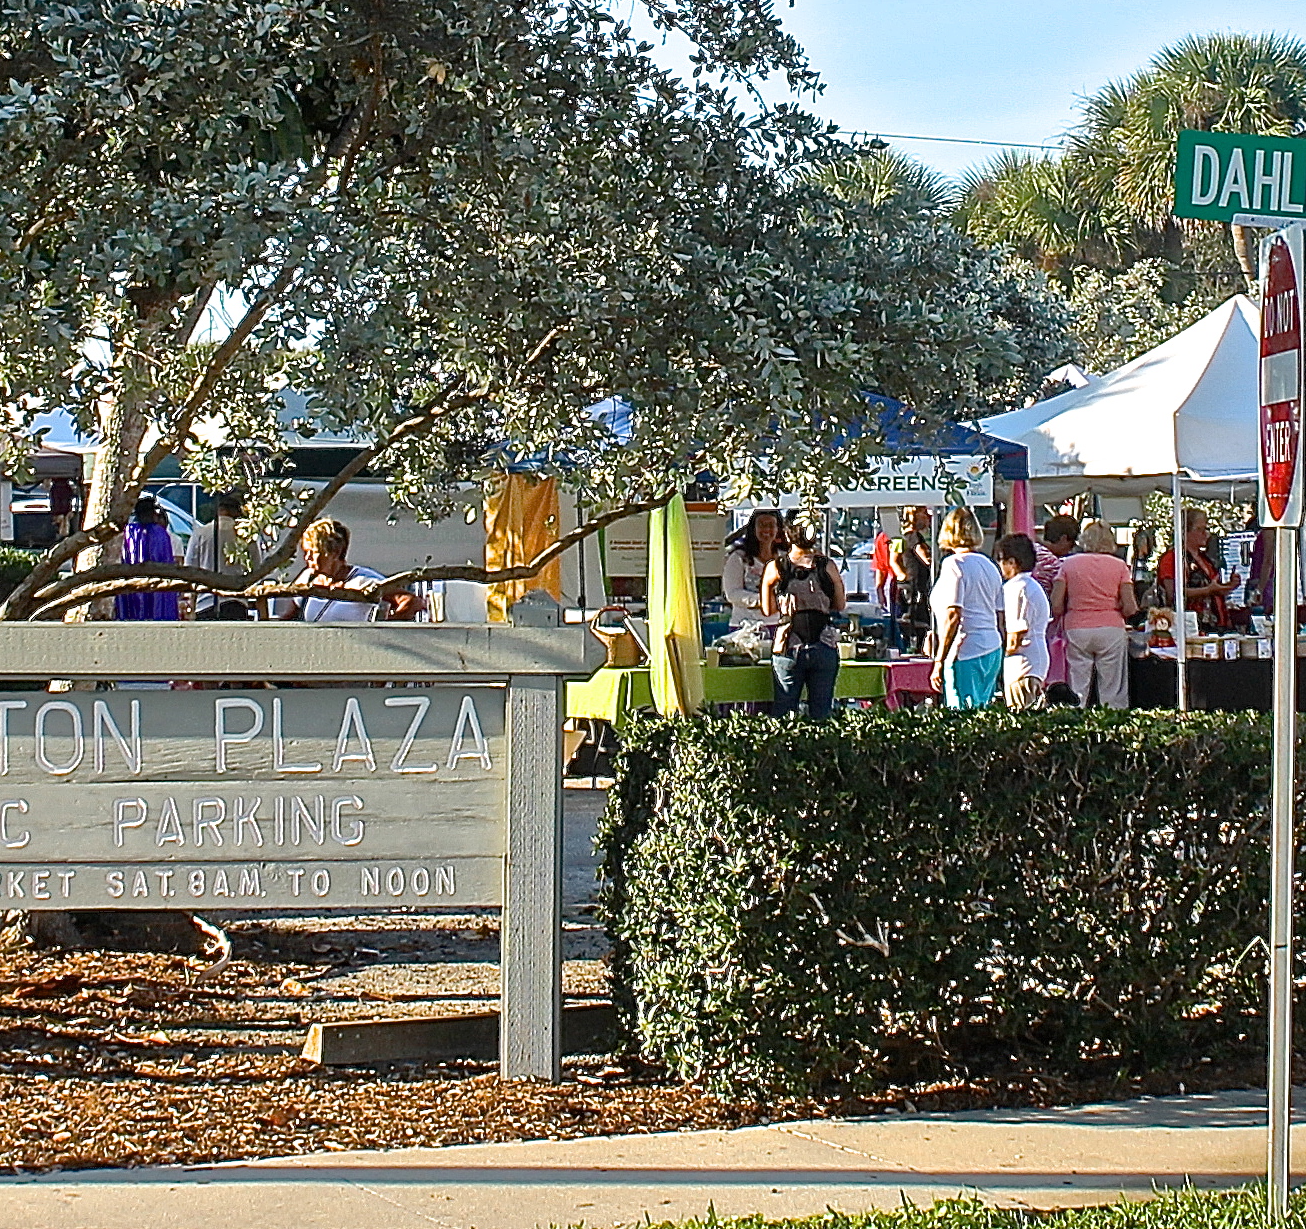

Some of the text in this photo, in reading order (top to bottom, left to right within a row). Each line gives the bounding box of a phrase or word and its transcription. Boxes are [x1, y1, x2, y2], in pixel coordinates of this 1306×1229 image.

[1263, 289, 1294, 338] DO NOT
[1266, 420, 1291, 464] ENTER
[215, 695, 492, 773] PLAZA
[114, 794, 364, 848] PARKING
[288, 868, 331, 897] TO
[361, 865, 456, 896] NOON
